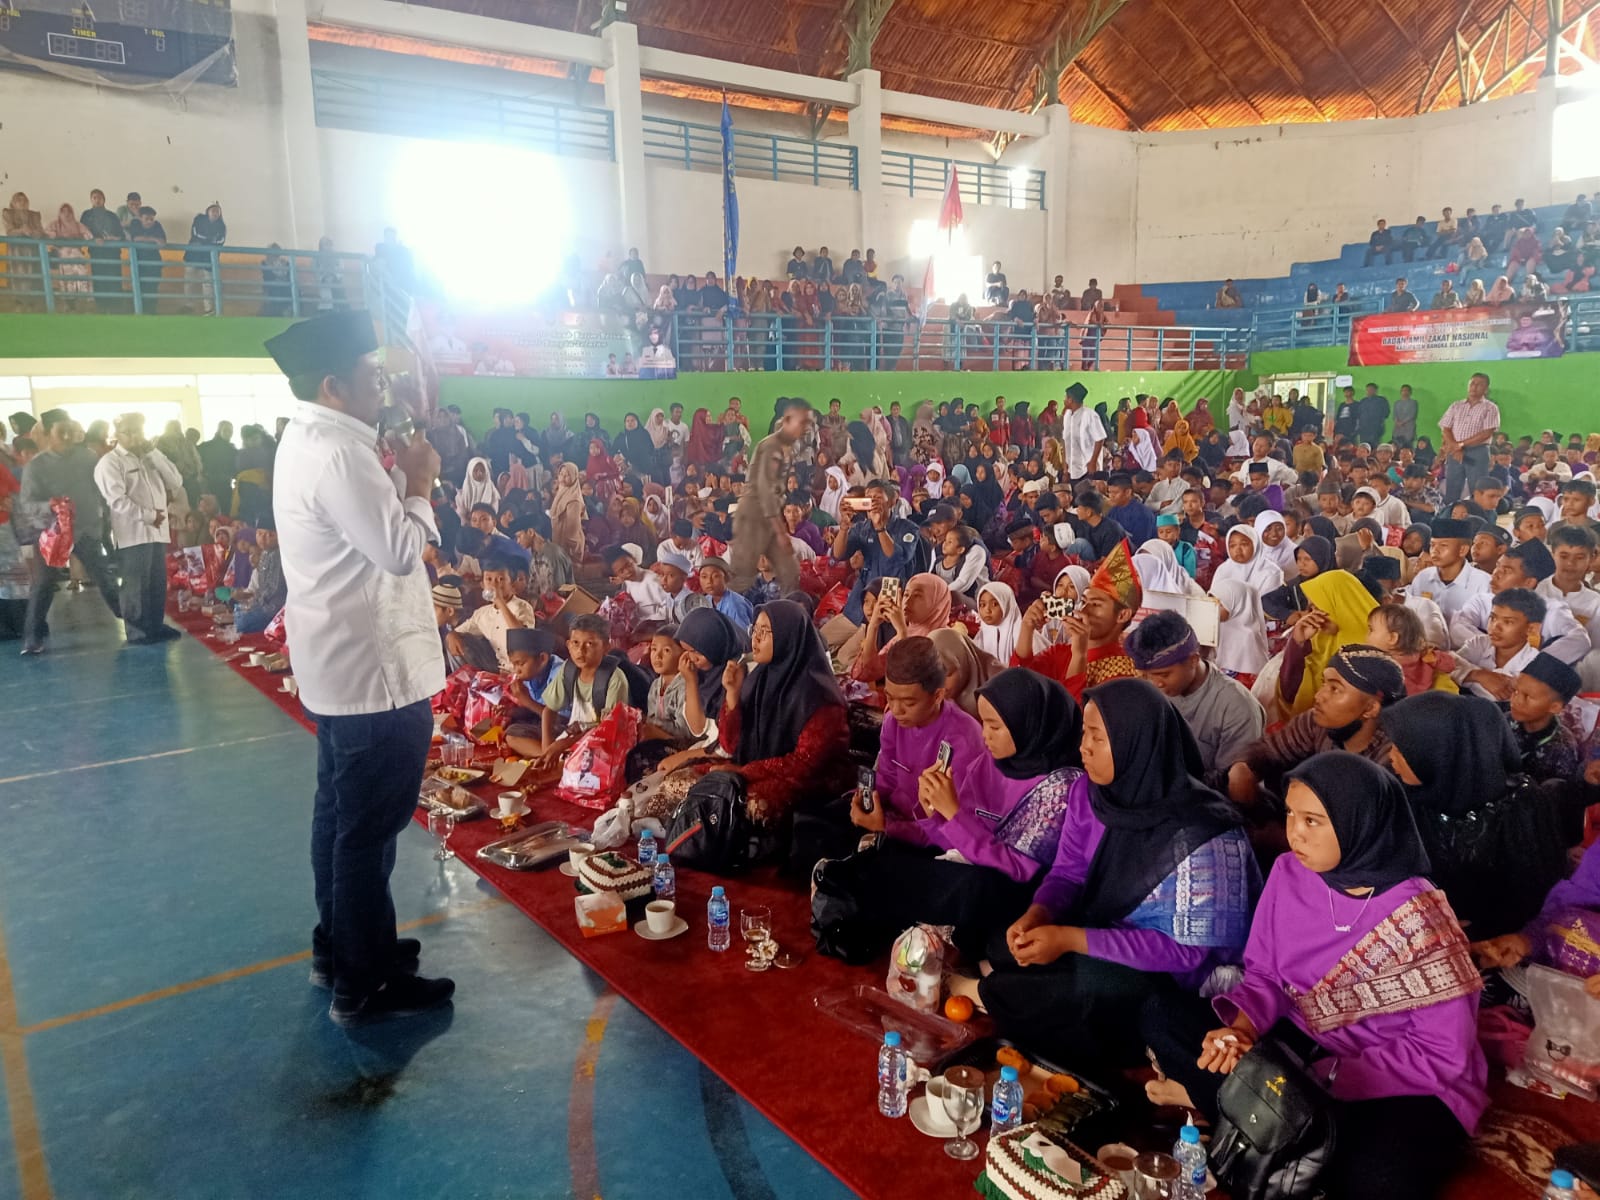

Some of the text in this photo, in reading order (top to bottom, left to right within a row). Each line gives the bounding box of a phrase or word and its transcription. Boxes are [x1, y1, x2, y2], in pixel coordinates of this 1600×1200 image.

[72, 28, 96, 38] TIMER
[1383, 332, 1488, 345] BADAN AMIL ZAKAT NASIONAL
